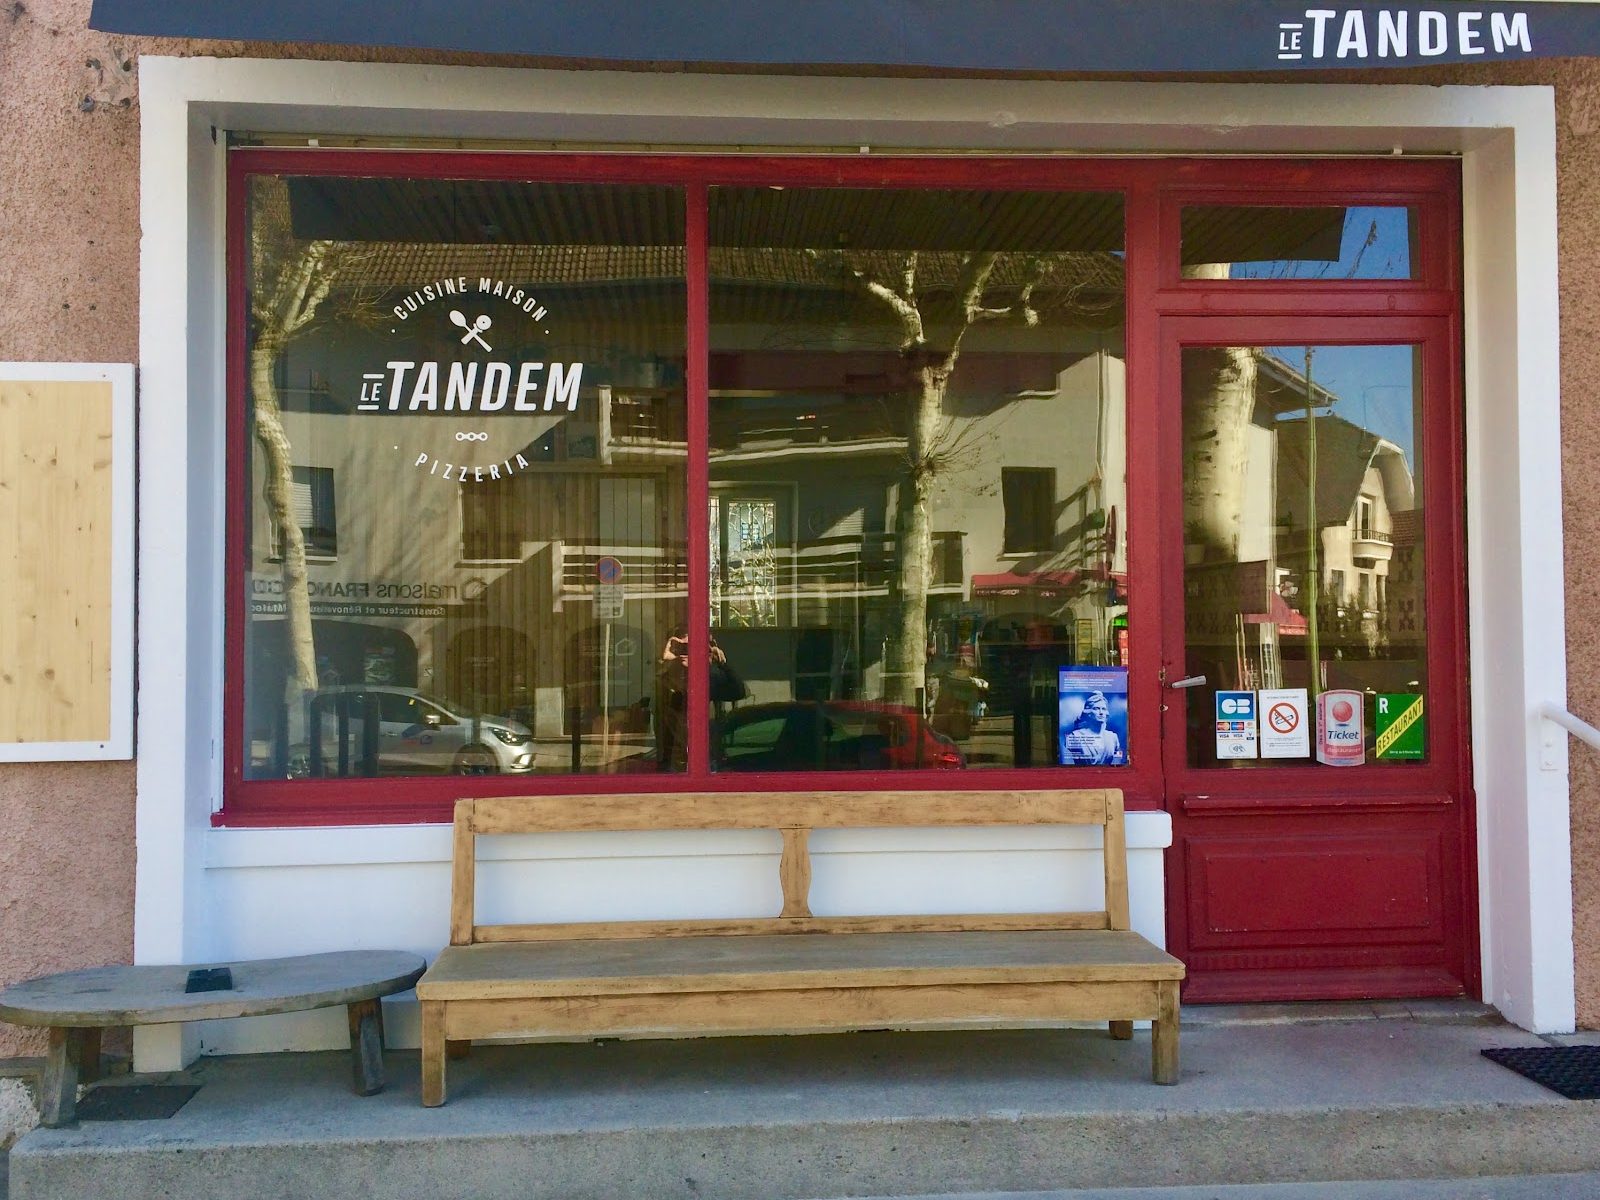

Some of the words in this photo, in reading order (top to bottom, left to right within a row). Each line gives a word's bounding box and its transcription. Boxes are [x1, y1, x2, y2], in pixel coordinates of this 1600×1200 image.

[1279, 32, 1302, 51] LE
[1305, 9, 1532, 59] TANDEM
[393, 277, 467, 321] CUISINE
[478, 277, 548, 322] MAISON
[360, 382, 382, 401] LE
[386, 361, 584, 411] TANDEM
[415, 452, 529, 482] PIZZERIA
[1377, 700, 1422, 753] RESTAURANT
[1379, 698, 1389, 714] R
[1328, 730, 1360, 741] Ticket
